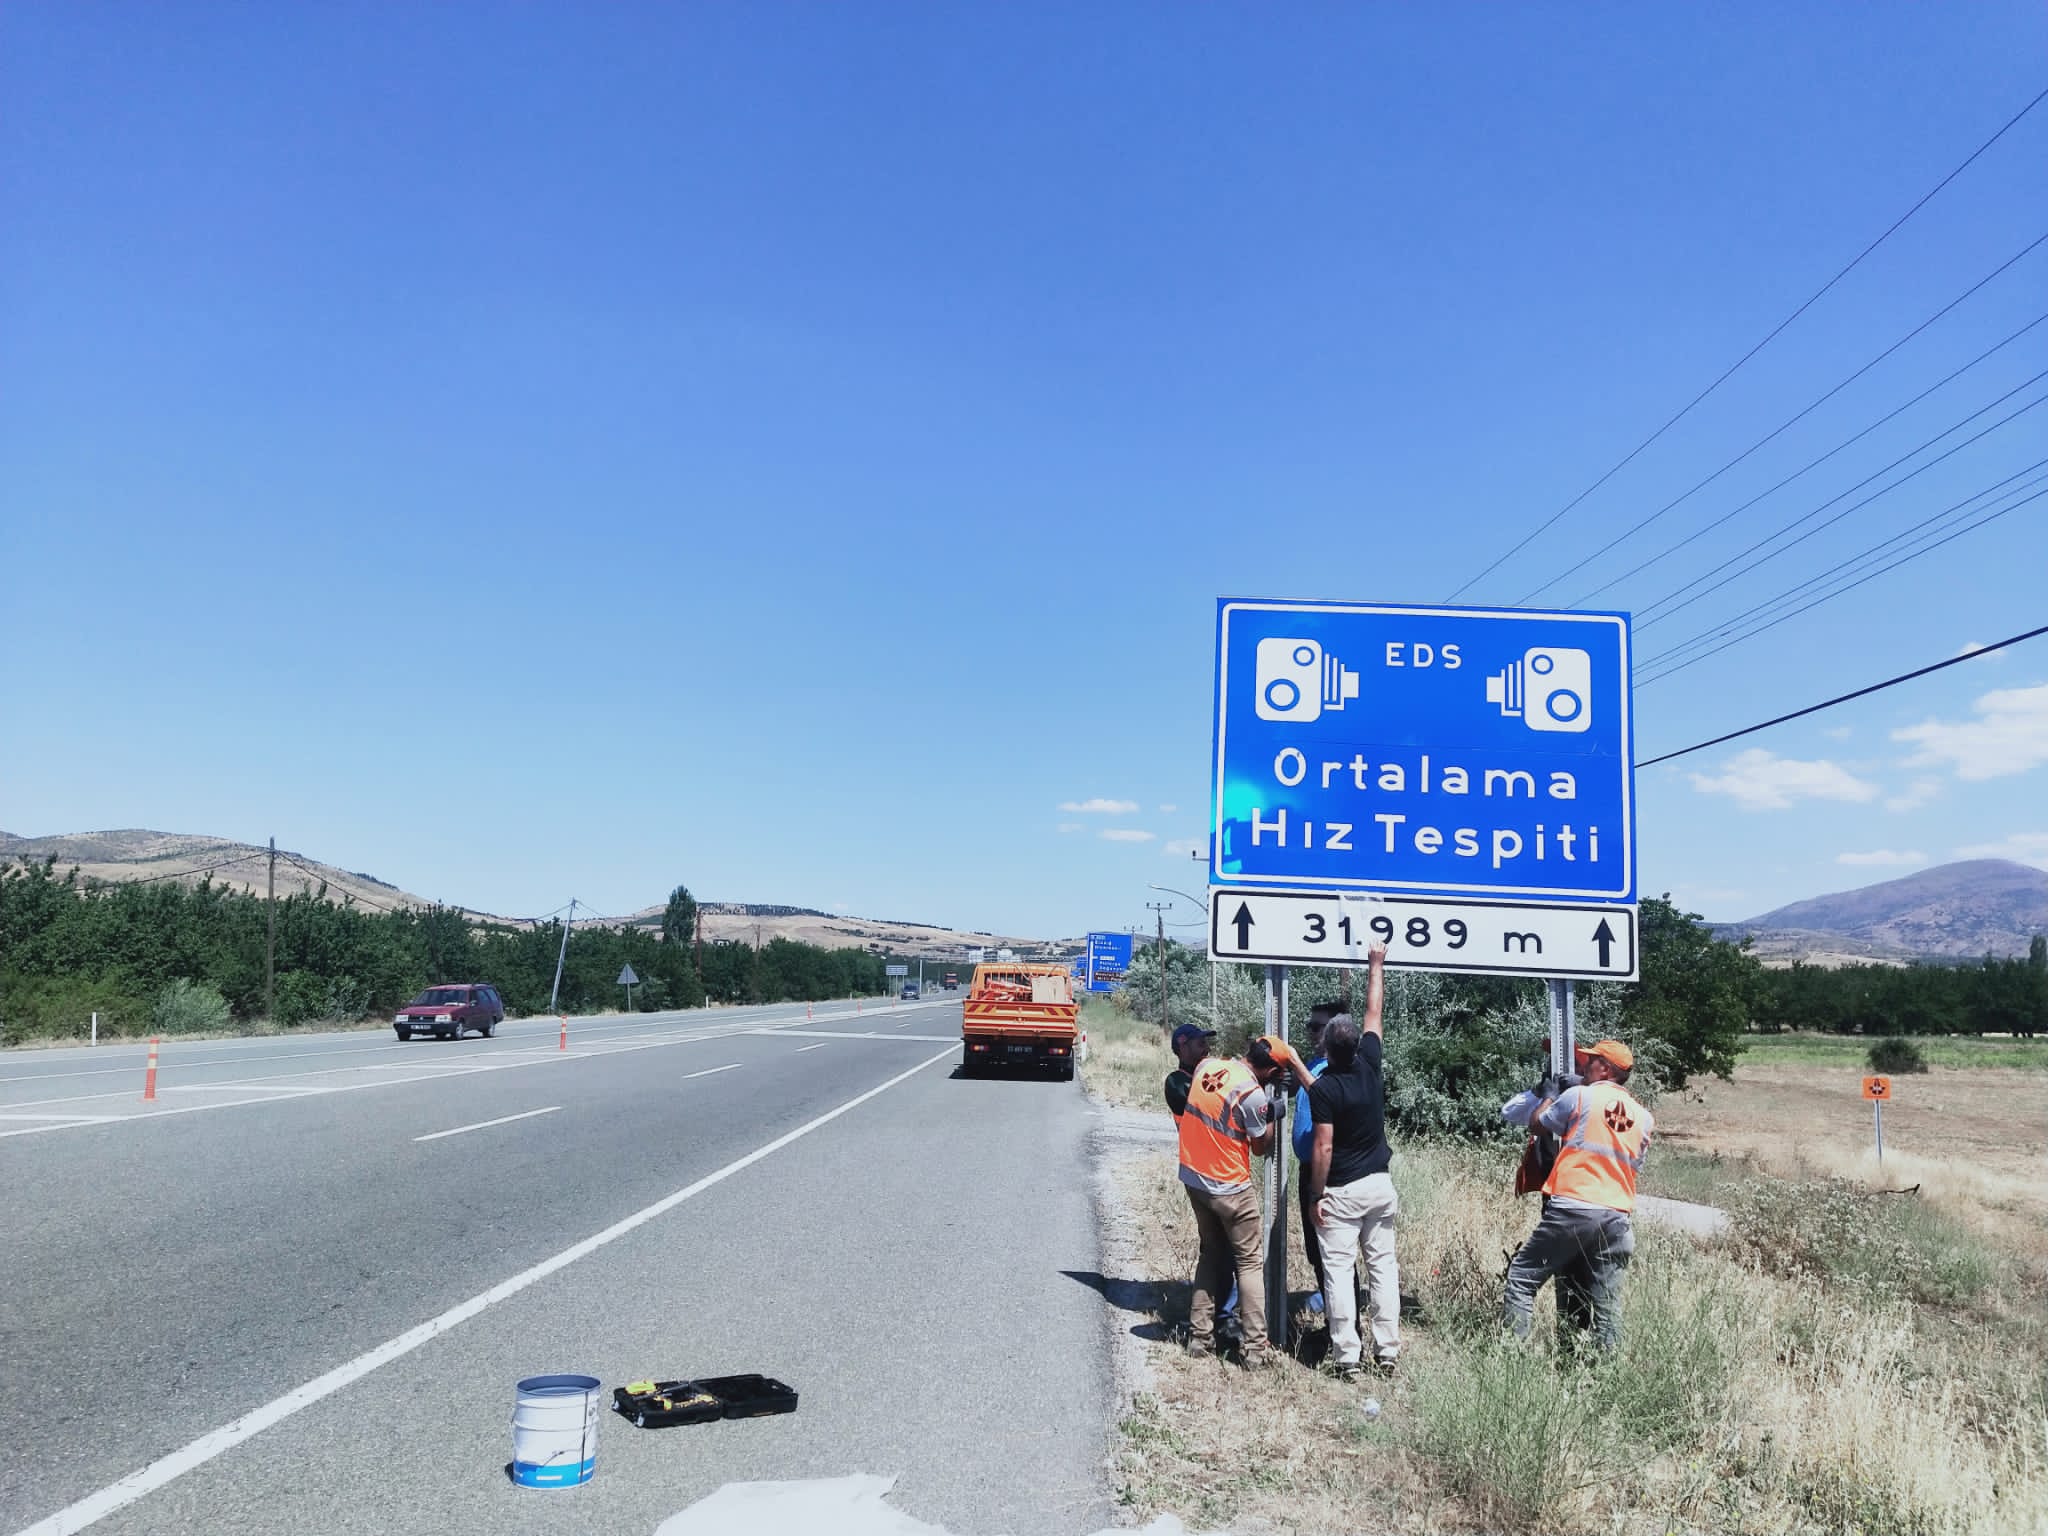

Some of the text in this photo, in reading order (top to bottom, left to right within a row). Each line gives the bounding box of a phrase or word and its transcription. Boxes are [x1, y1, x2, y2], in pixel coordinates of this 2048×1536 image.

[1386, 642, 1462, 669] EDS
[1274, 747, 1576, 800] Ortalama
[1251, 807, 1598, 869] Hız Tespiti
[1302, 913, 1543, 954] 31.989 m
